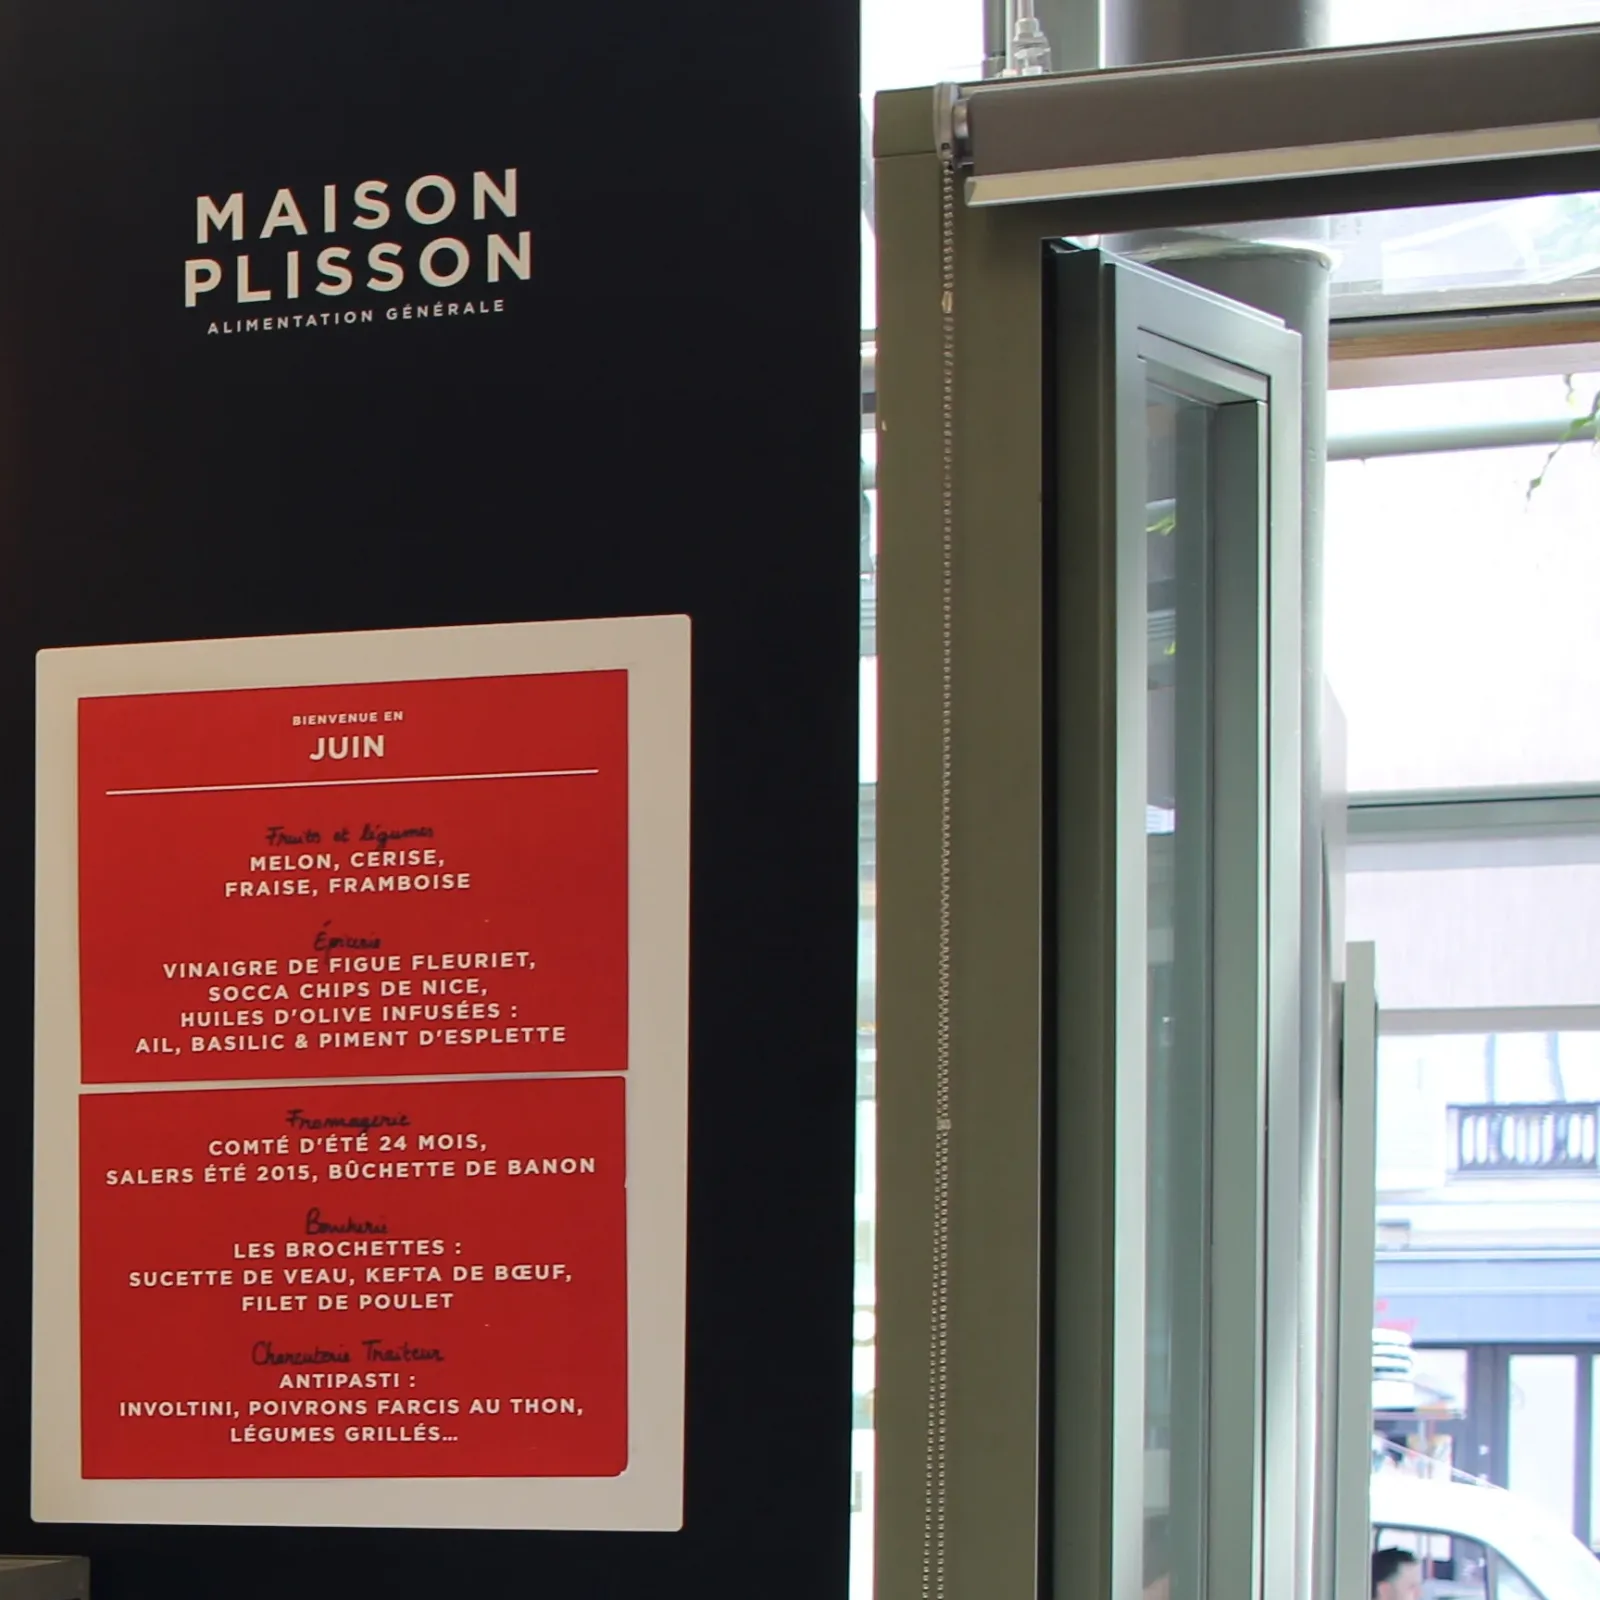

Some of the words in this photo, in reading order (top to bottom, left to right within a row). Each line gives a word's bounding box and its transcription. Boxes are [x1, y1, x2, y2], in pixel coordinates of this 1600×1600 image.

[196, 167, 518, 245] MAISON
[184, 230, 532, 308] PLISSON
[207, 309, 374, 335] ALIMENTATION
[385, 299, 505, 321] GÉNÉRALE
[292, 712, 378, 726] BIENVENUE
[383, 711, 404, 723] EN
[309, 734, 385, 761] JUIN
[265, 825, 321, 847] Fruits
[333, 826, 352, 843] et
[359, 823, 435, 850] légumes
[250, 853, 340, 872] MELON,
[350, 849, 445, 868] CERISE,
[225, 879, 318, 898] FRAISE,
[329, 872, 470, 894] FRAMBOISE
[163, 959, 278, 979] VINAIGRE
[288, 958, 319, 975] DE
[329, 955, 401, 973] FIGUE
[412, 951, 537, 971] FLEURIET,
[208, 984, 289, 1002] SOCCA
[299, 981, 370, 999] CHIPS
[381, 980, 412, 997] DE
[422, 978, 488, 997] NICE,
[181, 1009, 264, 1028] HUILES
[382, 1000, 501, 1022] INFUSÉES
[135, 1037, 182, 1055] AIL,
[191, 1034, 285, 1052] BASILIC
[294, 1033, 309, 1049] &
[319, 1030, 409, 1048] PIMENT
[285, 1107, 412, 1135] Fromagerie
[208, 1134, 290, 1156] COMTÉ
[379, 1135, 408, 1152] 24
[418, 1133, 487, 1152] MOIS,
[106, 1167, 194, 1185] SALERS
[204, 1162, 247, 1183] ÉTÉ
[256, 1164, 318, 1183] 2015,
[328, 1160, 455, 1180] BÛCHETTE
[466, 1160, 497, 1176] DE
[507, 1157, 596, 1175] BANON
[304, 1207, 389, 1236] Boucherie
[234, 1242, 275, 1259] LES
[286, 1239, 446, 1258] BROCHETTES
[129, 1270, 234, 1287] SUCETTE
[243, 1269, 273, 1285] DE
[283, 1268, 355, 1286] VEAU,
[366, 1266, 442, 1283] KEFTA
[453, 1265, 484, 1282] DE
[494, 1264, 573, 1283] BŒUF,
[242, 1296, 308, 1312] FILET
[318, 1295, 349, 1311] DE
[359, 1294, 455, 1310] POULET
[251, 1341, 351, 1366] Charcuterie
[361, 1339, 445, 1363] Traiteur
[279, 1372, 400, 1390] ANTIPASTI
[120, 1401, 240, 1419] INVOLTINI,
[249, 1399, 368, 1416] POIVRONS
[377, 1399, 460, 1415] FARCIS
[469, 1398, 501, 1414] AU
[510, 1398, 584, 1416] THON,
[230, 1423, 336, 1443] LÉGUMES
